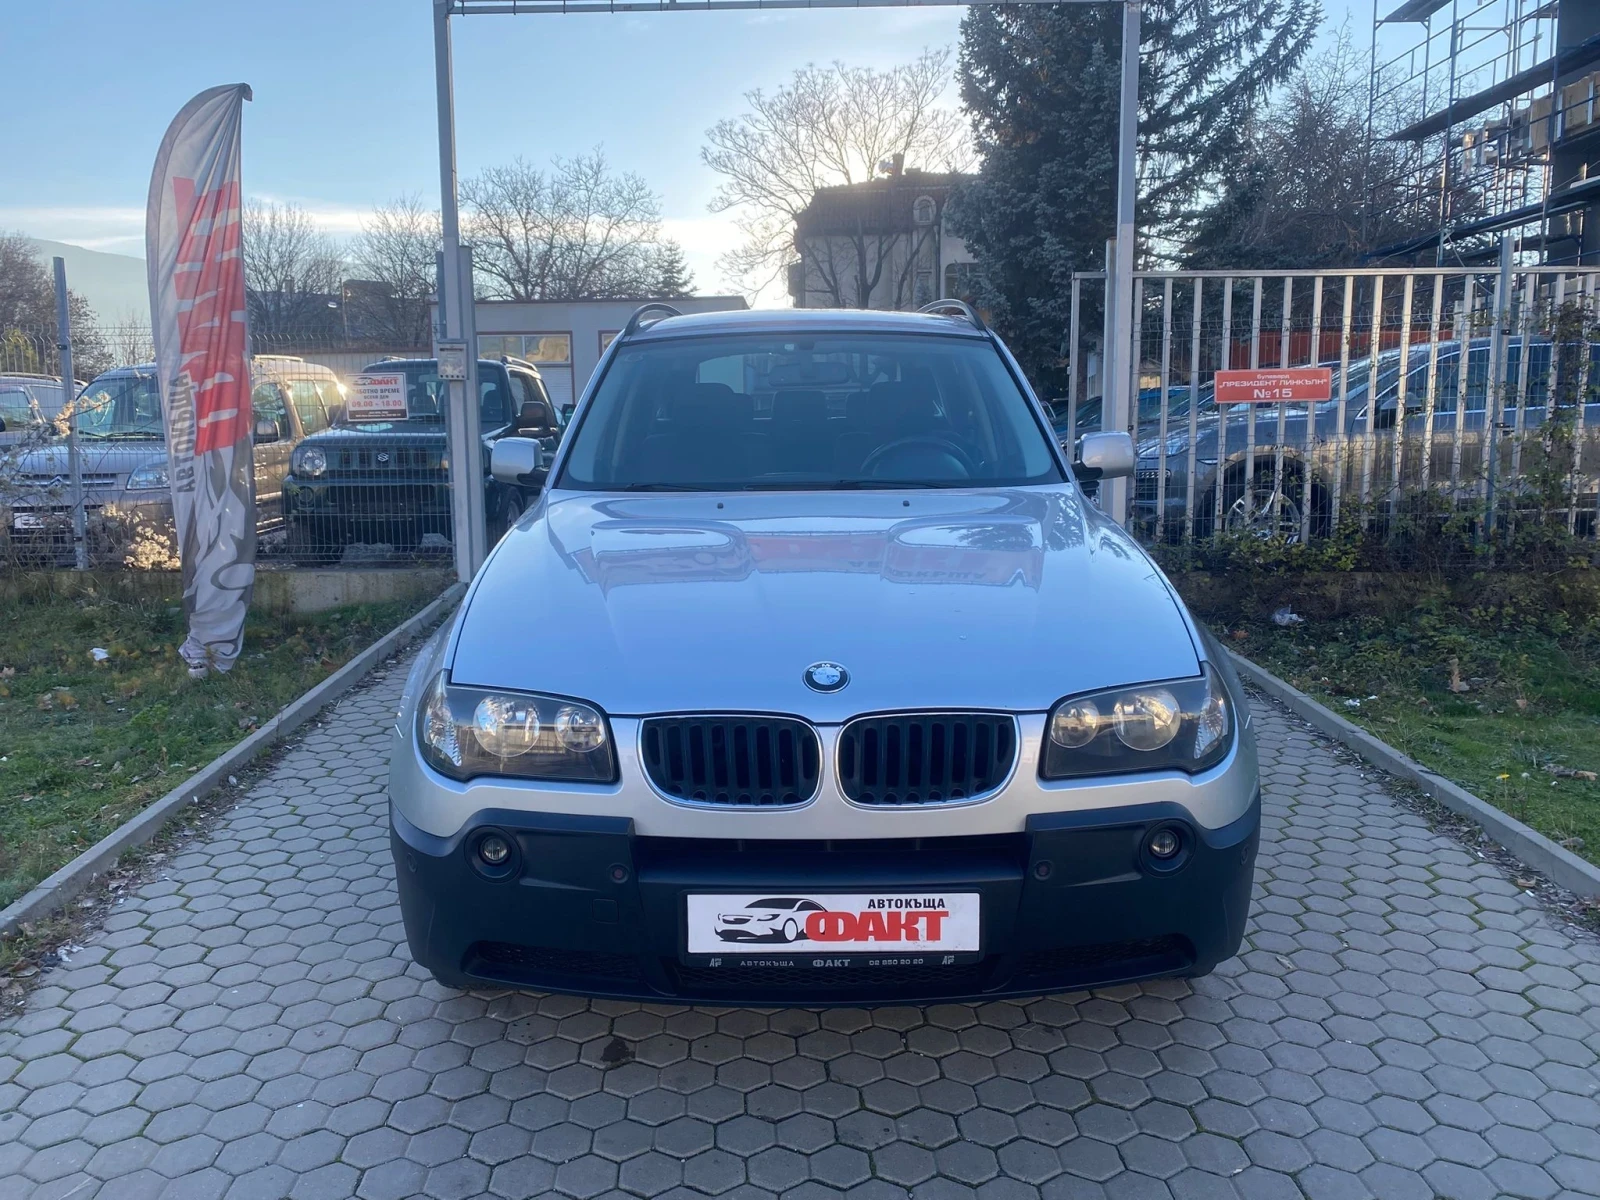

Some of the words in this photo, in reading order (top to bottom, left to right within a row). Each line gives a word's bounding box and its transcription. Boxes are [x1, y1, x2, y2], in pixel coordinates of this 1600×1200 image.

[169, 371, 196, 494] АВТОКЪЩА
[867, 898, 946, 909] АВТОКЪЩА
[805, 911, 949, 942] ФАКТ
[812, 959, 851, 967] ФАКТ
